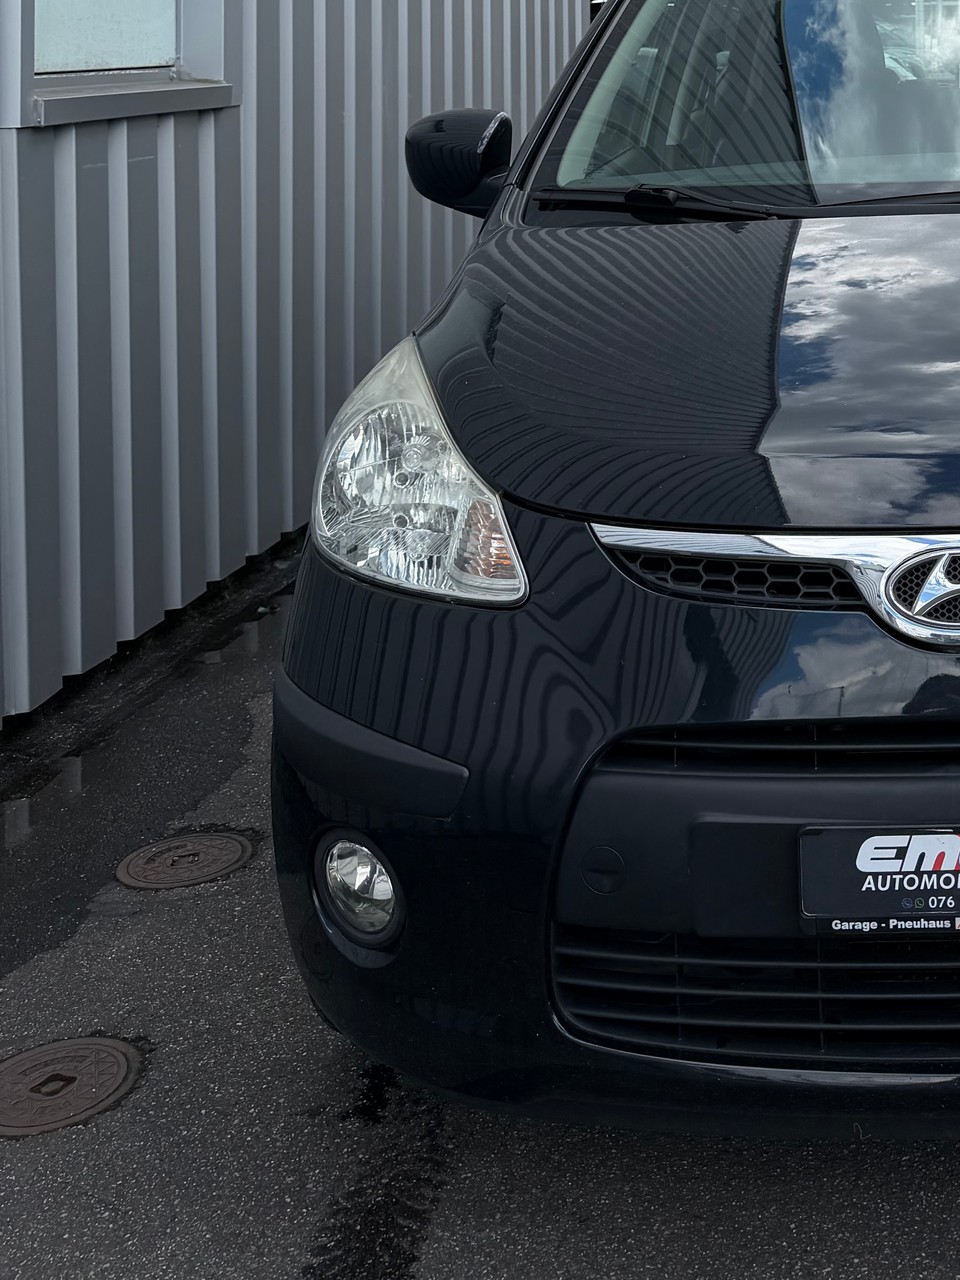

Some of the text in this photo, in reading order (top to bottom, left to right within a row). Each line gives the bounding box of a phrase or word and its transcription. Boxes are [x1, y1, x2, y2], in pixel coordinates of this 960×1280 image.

[928, 896, 955, 908] 076
[831, 920, 878, 931] Garage
[889, 919, 951, 929] Pneuhaus
